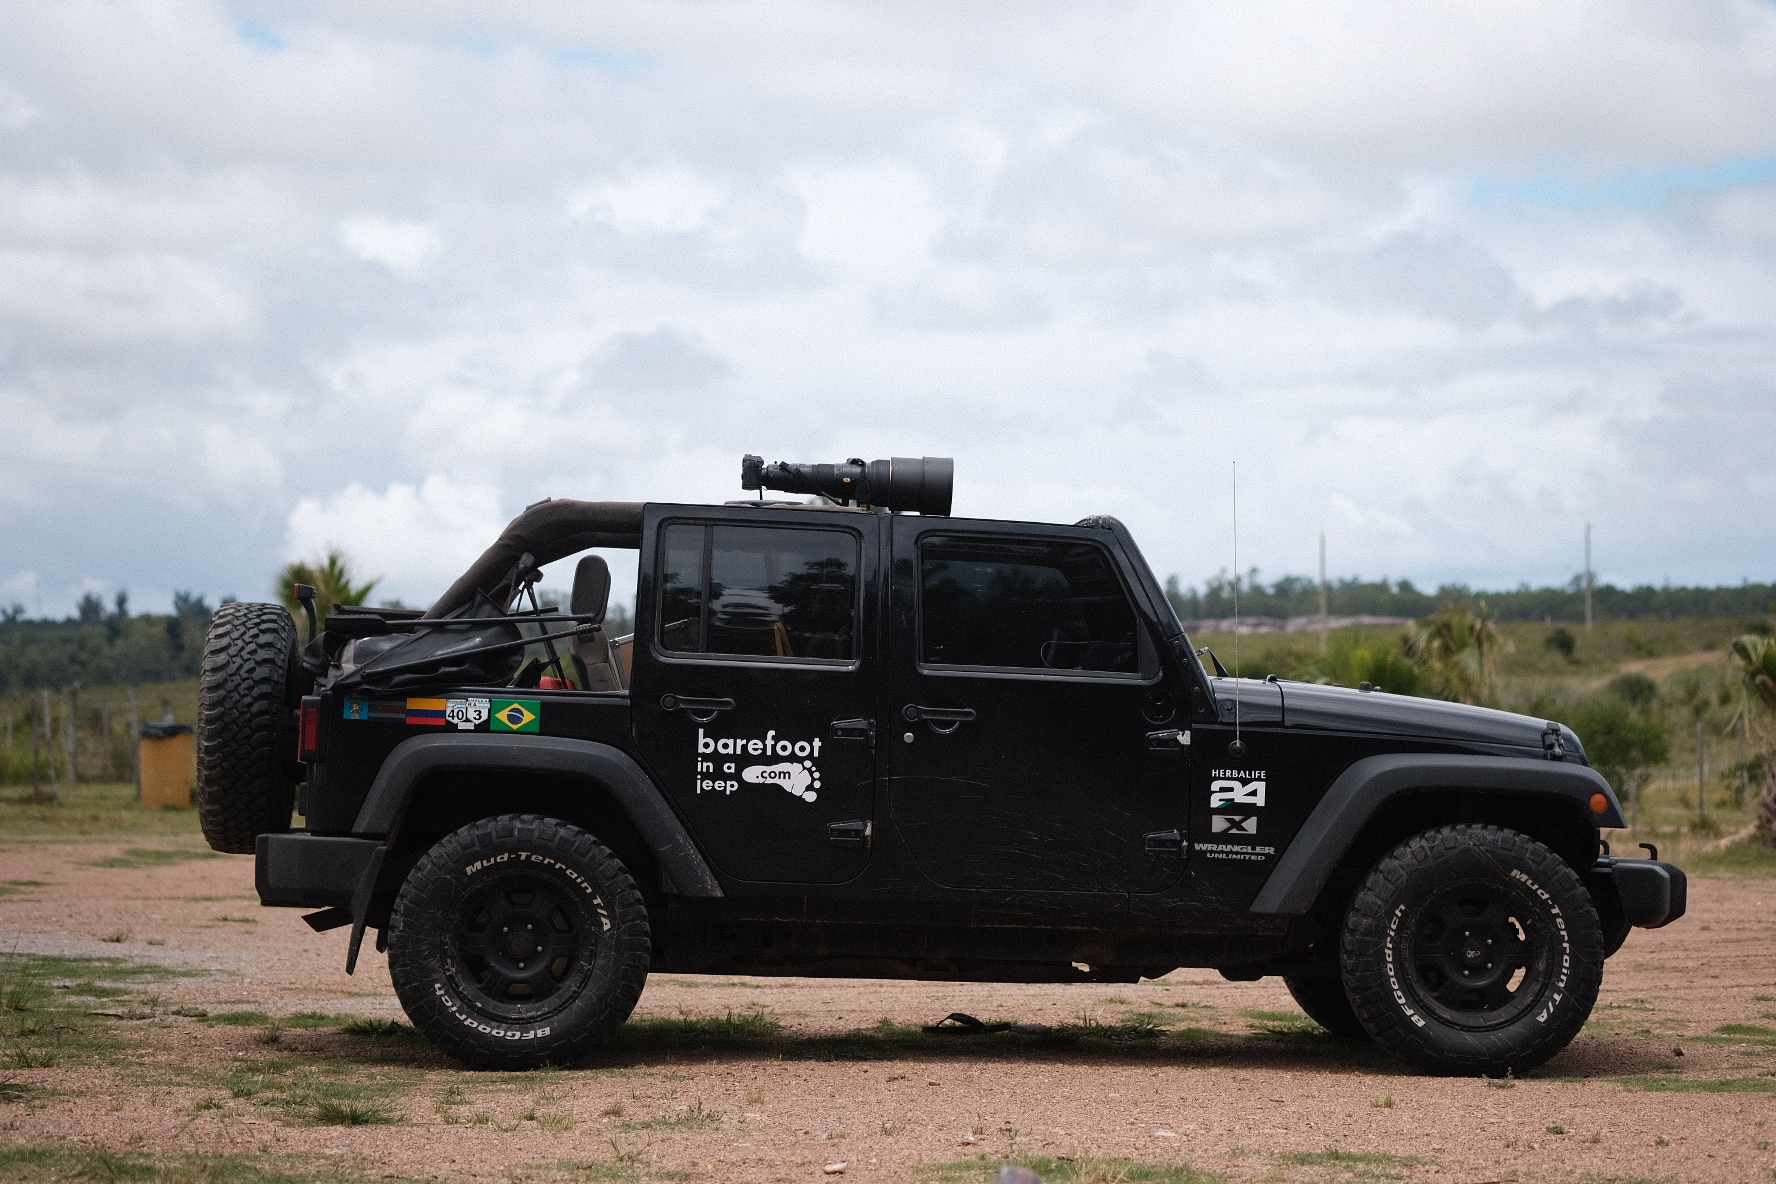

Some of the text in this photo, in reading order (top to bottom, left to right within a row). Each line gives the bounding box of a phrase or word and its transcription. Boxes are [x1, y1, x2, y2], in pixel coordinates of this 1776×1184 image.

[448, 709, 464, 720] 40
[472, 709, 482, 720] 3
[698, 728, 822, 758] barefoot
[697, 757, 736, 773] in a
[1211, 769, 1267, 779] HERBALIFE
[755, 770, 792, 780] .com
[697, 774, 739, 795] jeep
[1210, 780, 1267, 808] 24
[1194, 843, 1275, 854] WRANGLER
[1206, 852, 1266, 861] UNLIMITED
[465, 851, 612, 931] Mud-Terrain T/A
[1510, 868, 1570, 1023] Mud-Terrain T/A
[1385, 904, 1426, 1028] BFGoodrich
[434, 983, 551, 1040] BFGoodrich
